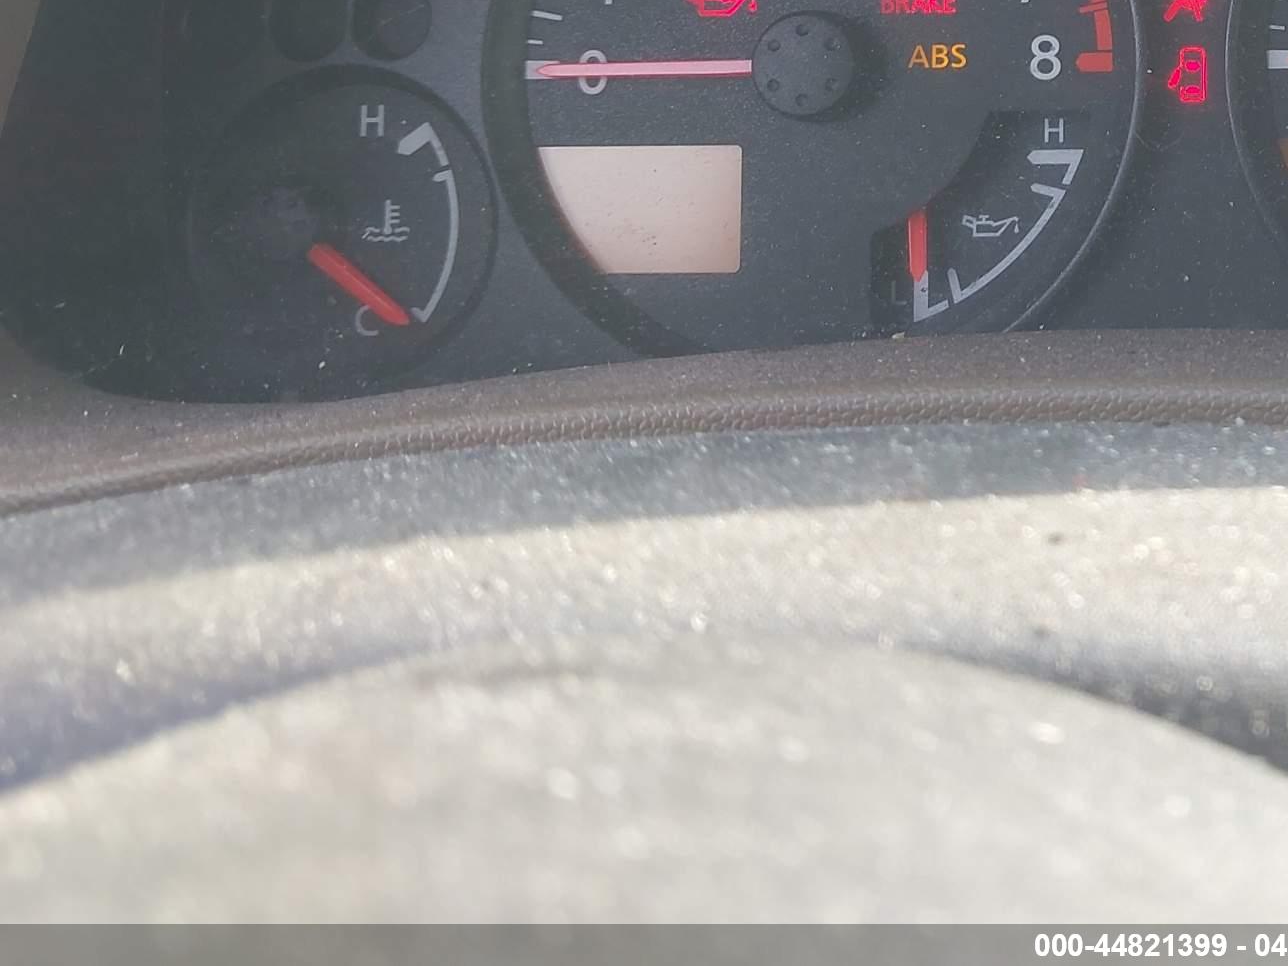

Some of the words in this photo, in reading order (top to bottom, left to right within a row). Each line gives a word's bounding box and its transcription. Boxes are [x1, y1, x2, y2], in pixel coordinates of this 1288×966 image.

[908, 44, 967, 68] ABS
[1030, 34, 1062, 81] 8
[360, 104, 385, 136] H
[1044, 118, 1064, 143] H
